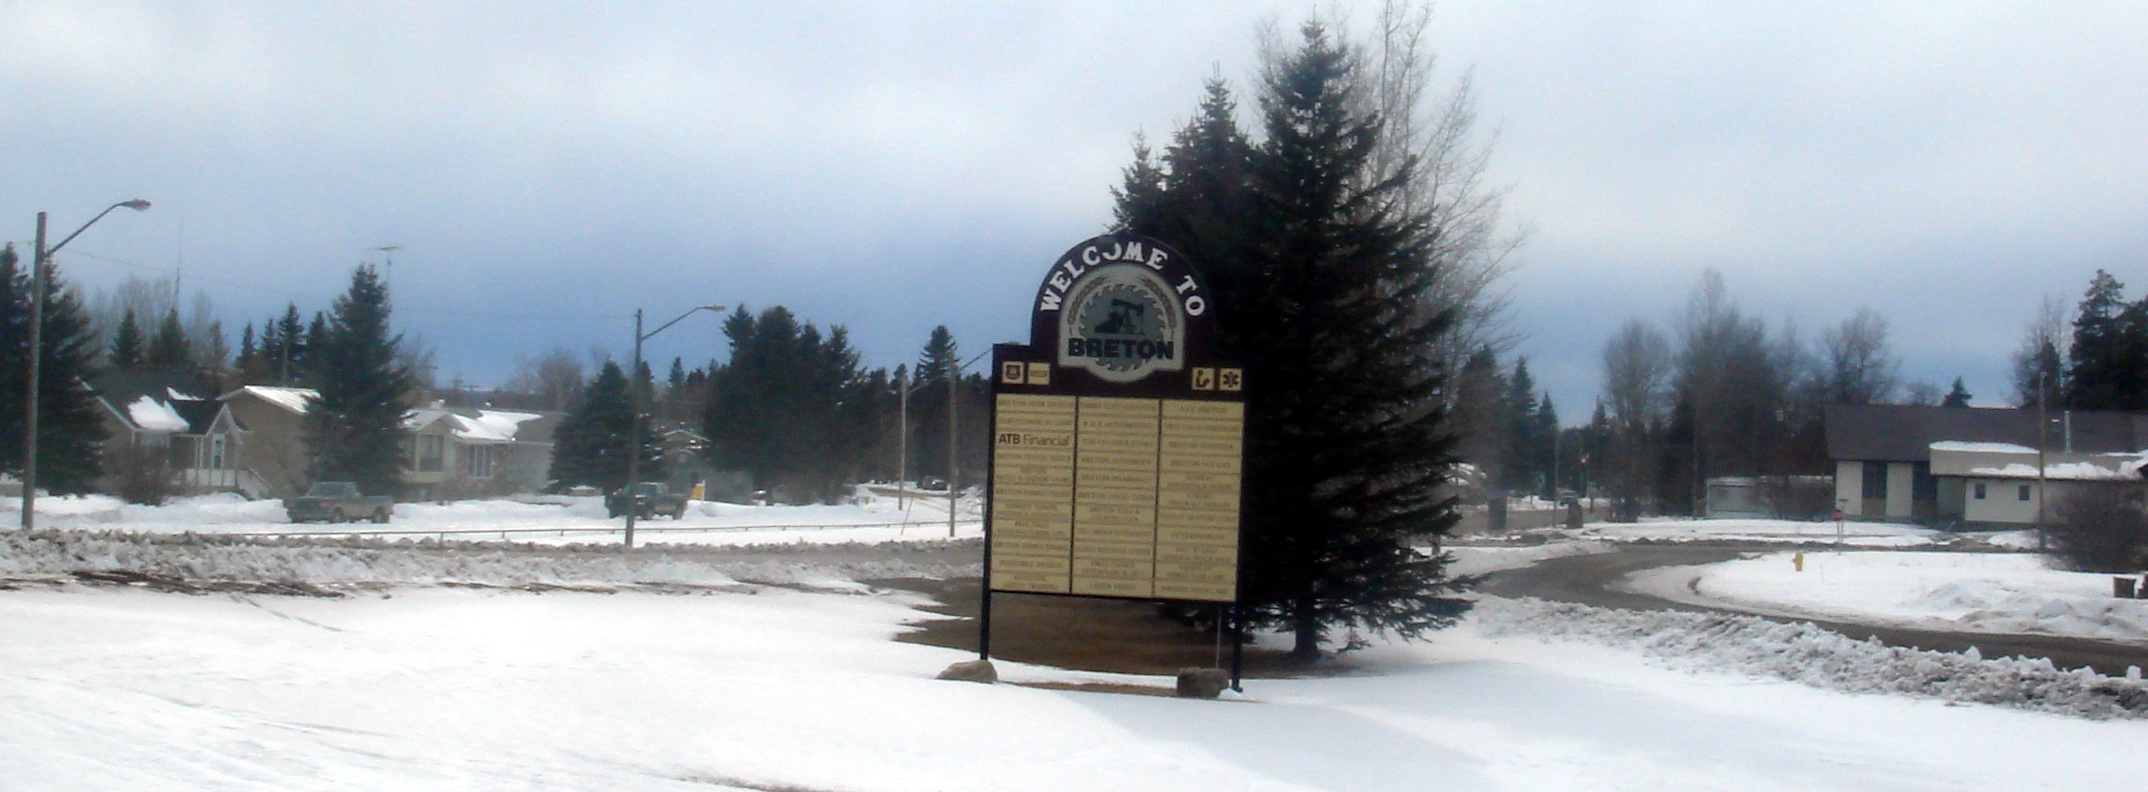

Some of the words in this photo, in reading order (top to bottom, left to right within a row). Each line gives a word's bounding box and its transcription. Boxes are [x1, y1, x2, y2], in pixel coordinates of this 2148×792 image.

[1040, 241, 1168, 311] WELCOME
[1176, 275, 1205, 316] TO
[1068, 338, 1174, 360] BRETON
[998, 433, 1020, 445] ATB
[1023, 433, 1070, 446] Financial
